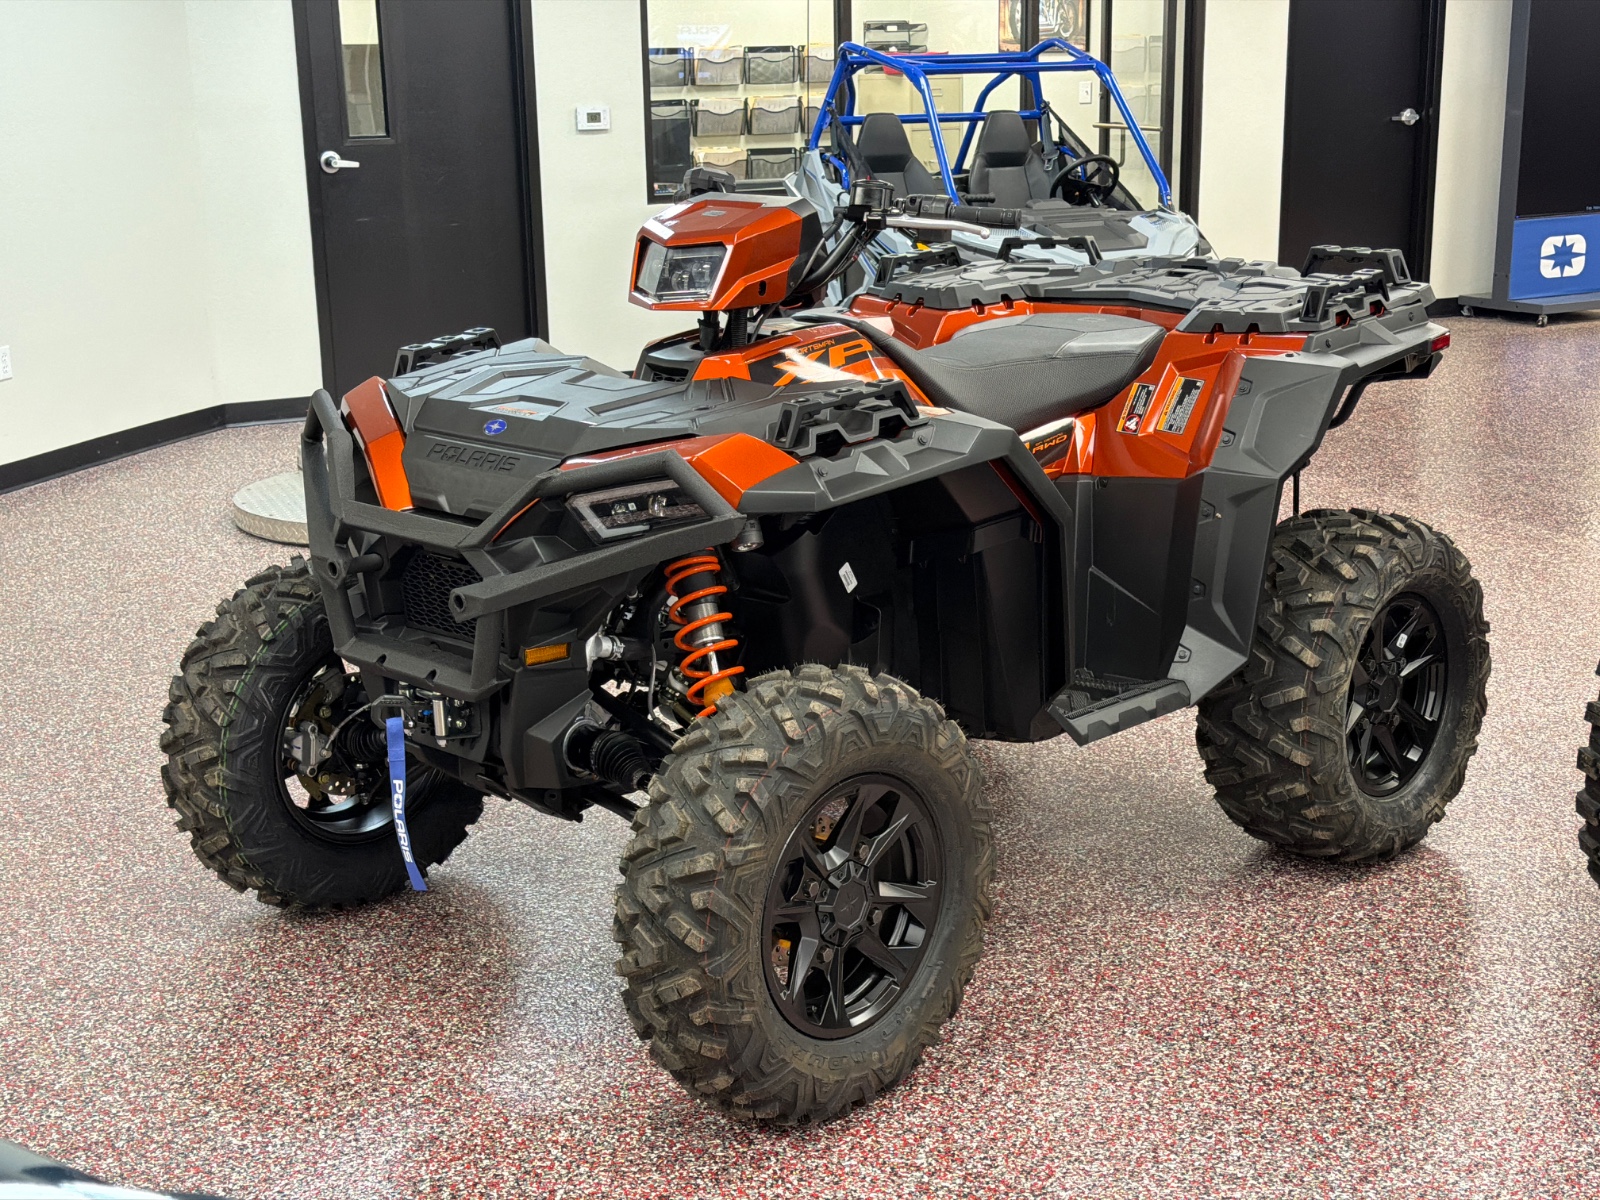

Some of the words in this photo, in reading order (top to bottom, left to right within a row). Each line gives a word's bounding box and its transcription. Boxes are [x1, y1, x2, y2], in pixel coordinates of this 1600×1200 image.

[426, 442, 521, 472] POLARIS
[1032, 434, 1068, 454] AWD
[392, 779, 414, 863] POLARIS
